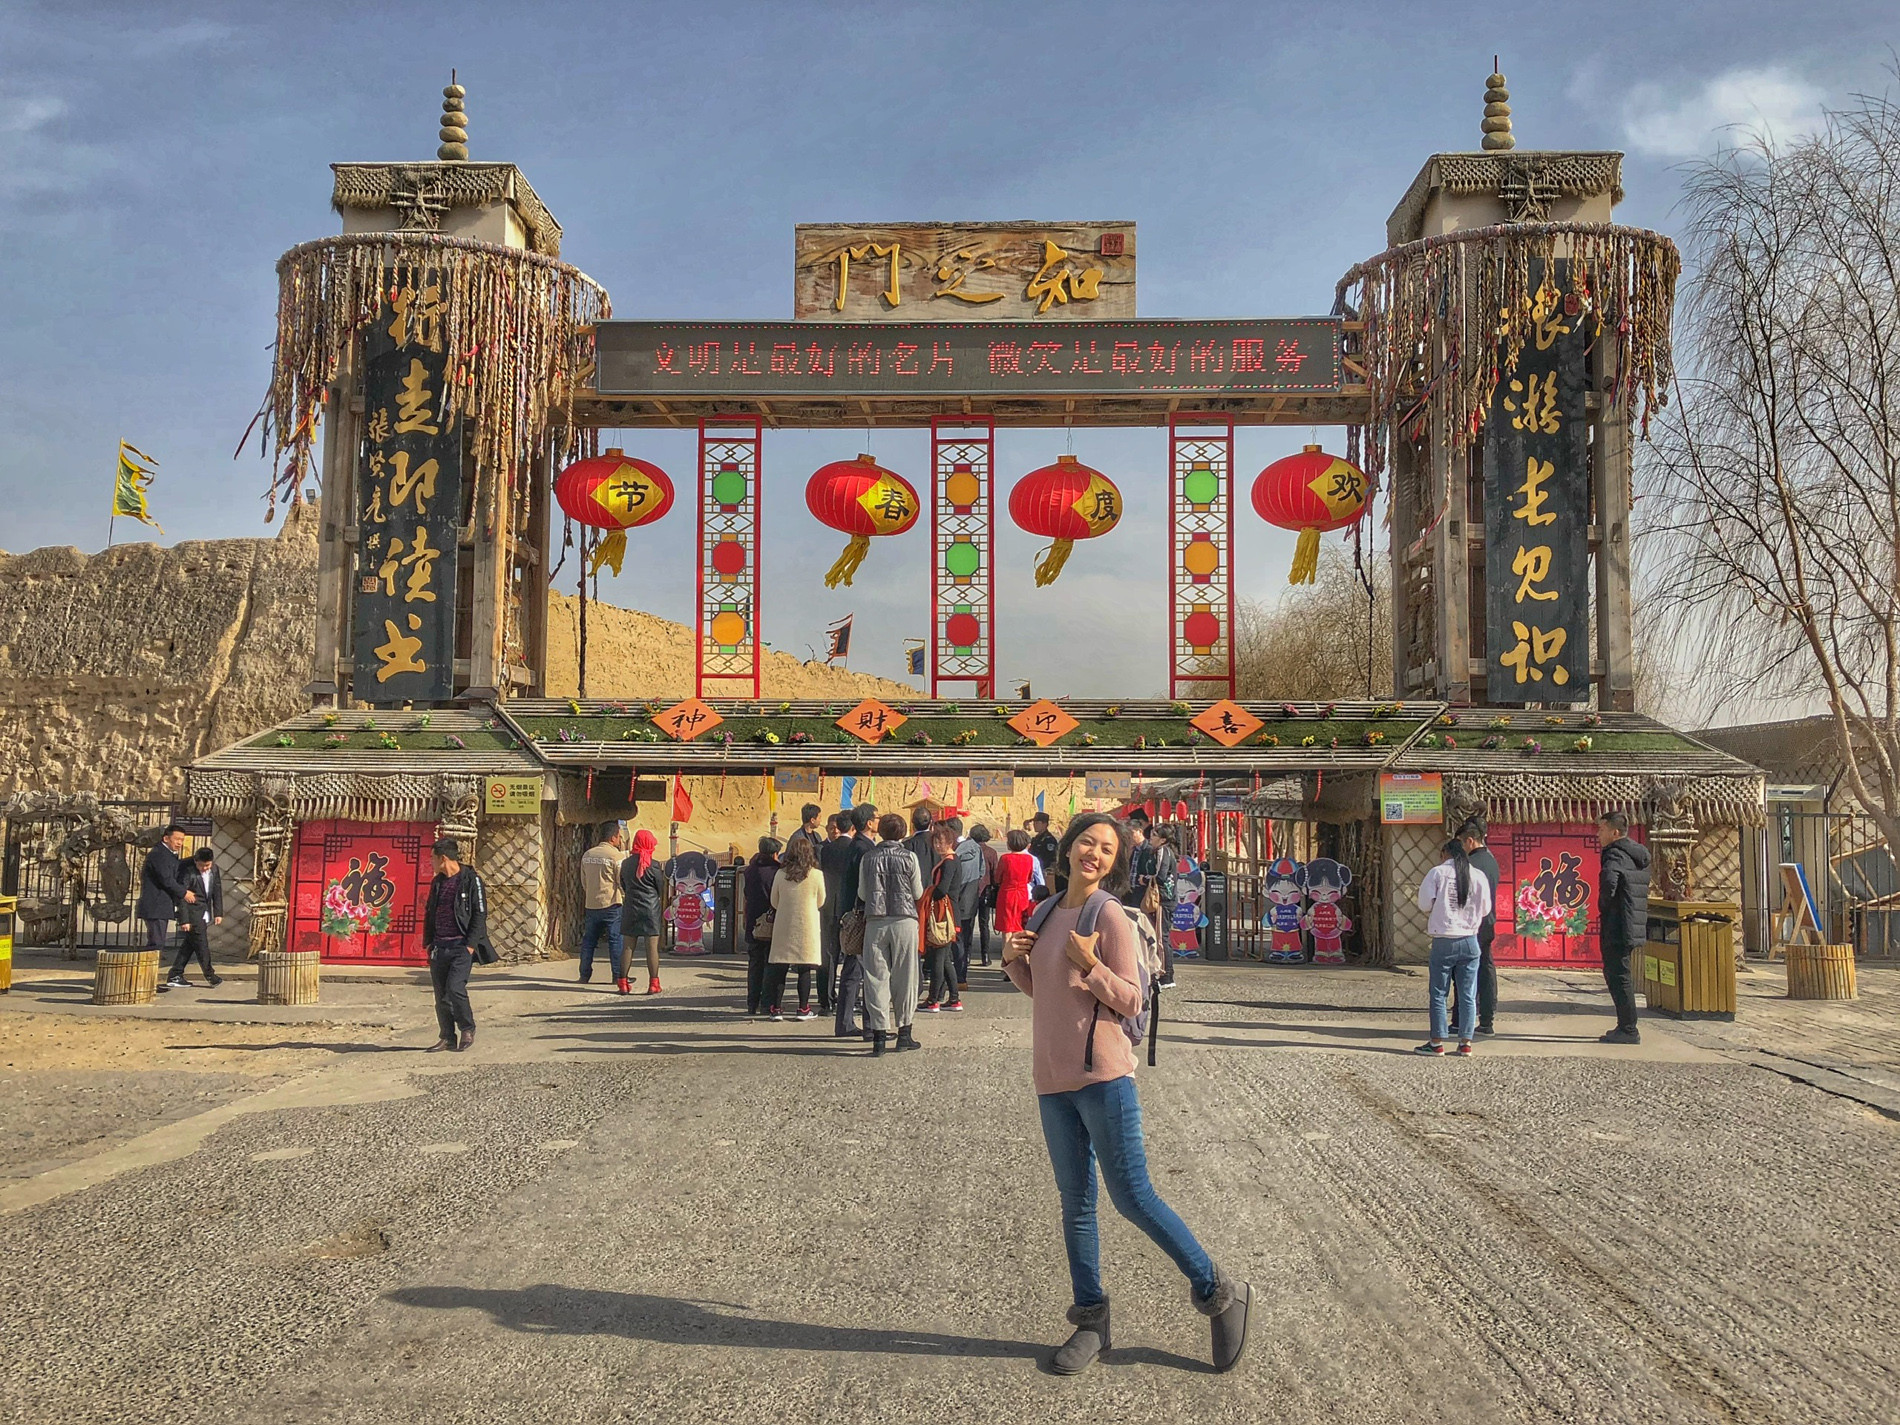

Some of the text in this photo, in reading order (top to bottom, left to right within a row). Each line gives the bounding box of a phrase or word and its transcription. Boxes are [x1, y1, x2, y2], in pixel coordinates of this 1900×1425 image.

[653, 339, 1308, 377] 文明是最好的名片 微笑是最好的服务
[609, 480, 649, 513] 节
[874, 487, 910, 521] 春
[1327, 471, 1363, 504] 欢
[1090, 489, 1118, 522] 度
[671, 708, 707, 731] 神
[1025, 711, 1059, 735] 迎
[1210, 710, 1247, 735] 喜
[340, 847, 396, 908] 福
[1533, 851, 1591, 909] 福
